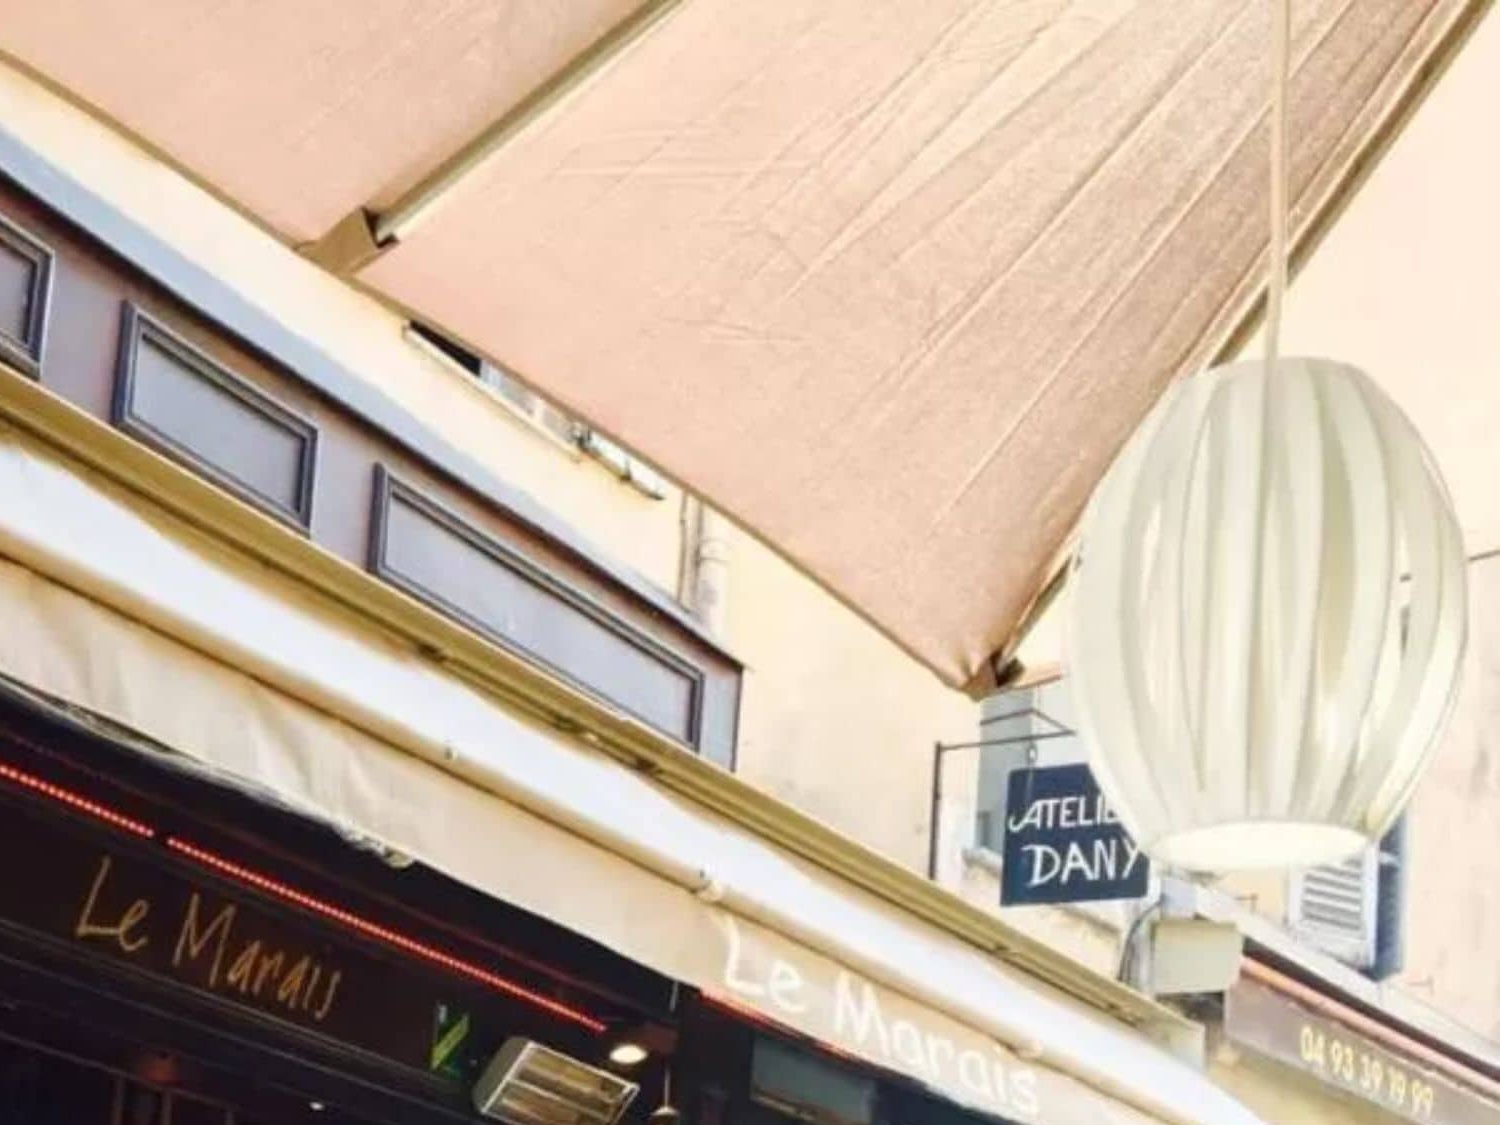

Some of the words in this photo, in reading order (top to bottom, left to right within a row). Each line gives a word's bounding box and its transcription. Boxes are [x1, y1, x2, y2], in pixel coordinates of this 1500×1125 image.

[1022, 836, 1141, 888] DANY
[74, 855, 149, 952] Le
[172, 892, 341, 1021] Marais
[718, 914, 810, 1012] Le
[833, 969, 1041, 1116] Marais
[1301, 1025, 1325, 1067] 04
[1331, 1039, 1354, 1081] 93
